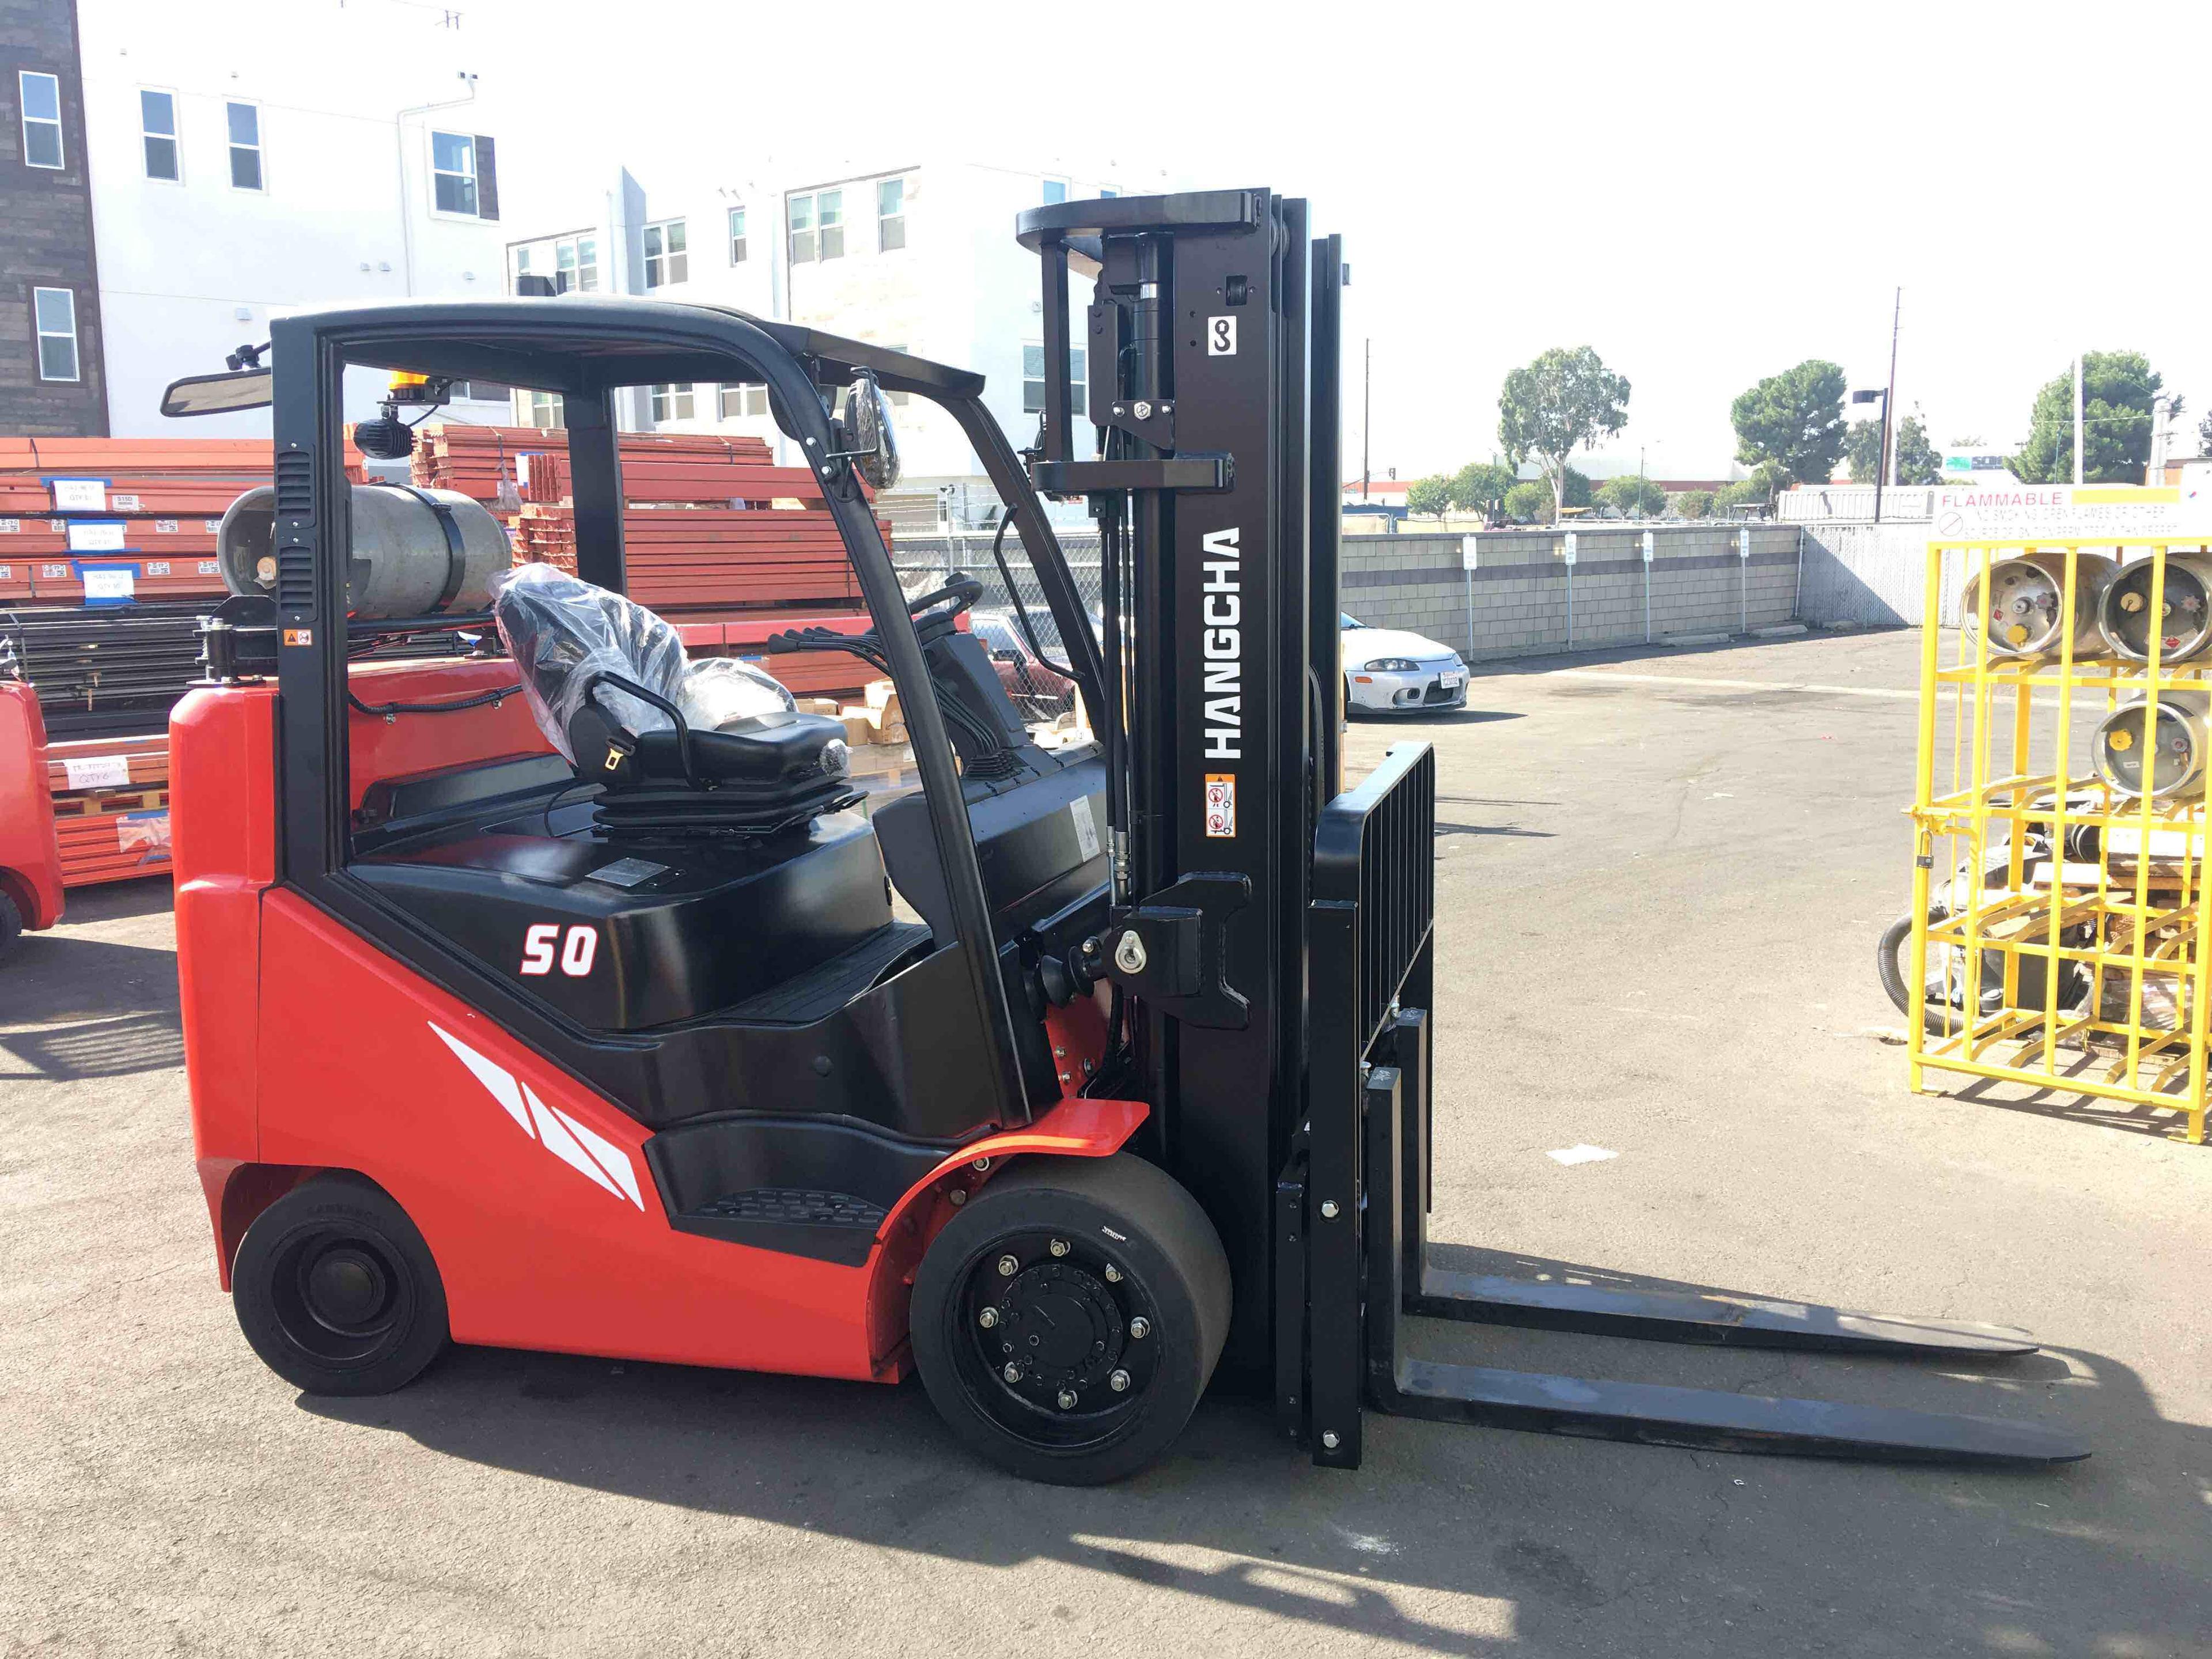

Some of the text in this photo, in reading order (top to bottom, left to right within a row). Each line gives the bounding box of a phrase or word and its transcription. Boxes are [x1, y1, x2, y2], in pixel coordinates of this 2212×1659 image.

[1942, 492, 2062, 507] FLAMMABLE
[1993, 507, 2037, 521] SMOKNG
[1203, 527, 1241, 759] HANGCHA
[520, 922, 599, 977] 50
